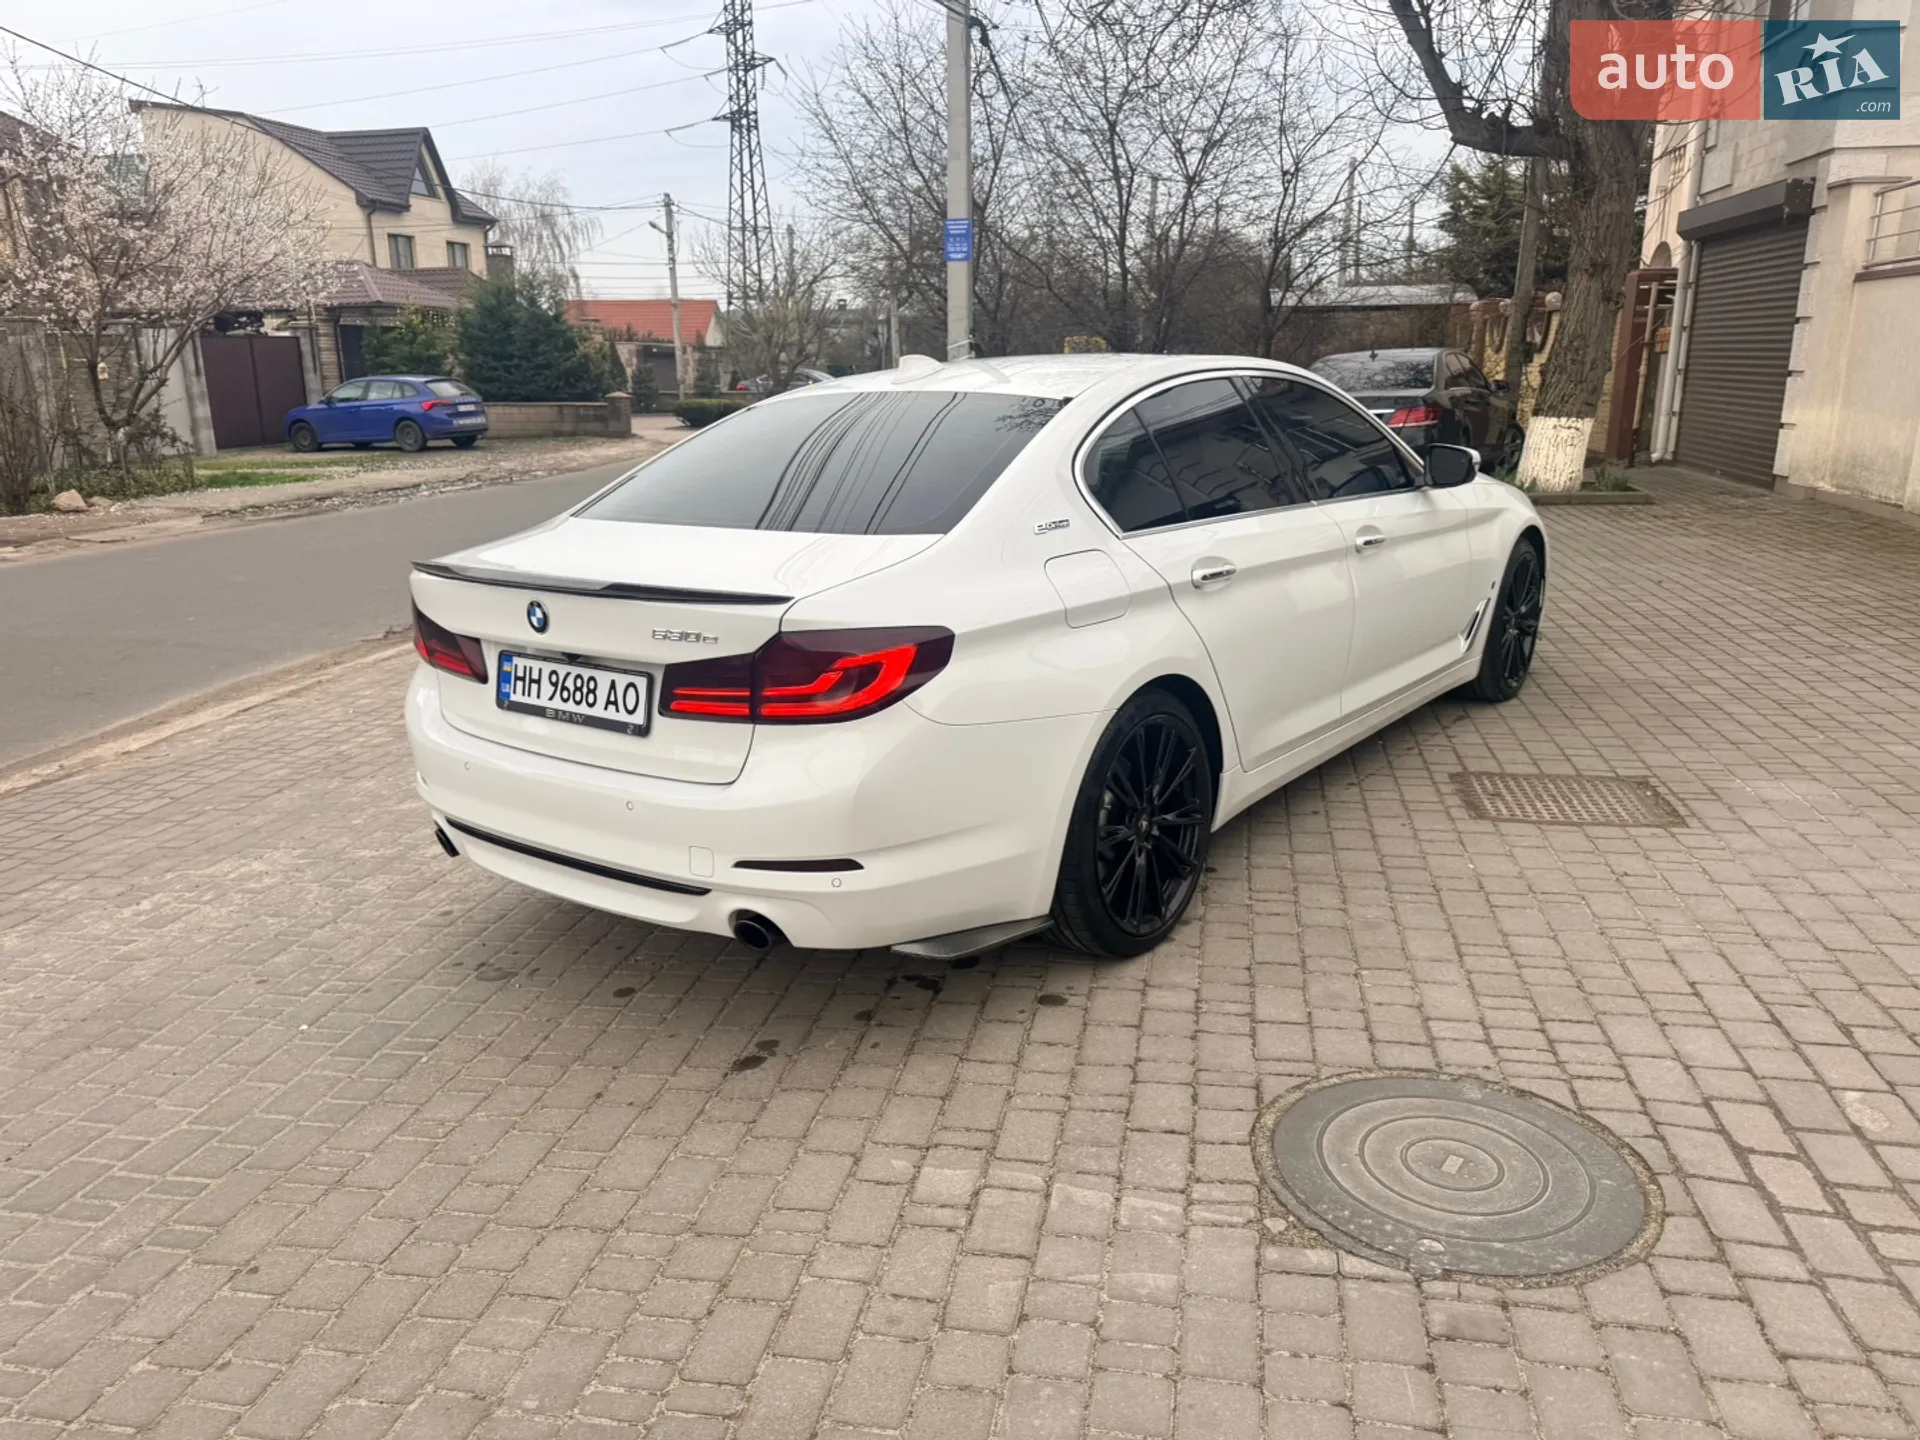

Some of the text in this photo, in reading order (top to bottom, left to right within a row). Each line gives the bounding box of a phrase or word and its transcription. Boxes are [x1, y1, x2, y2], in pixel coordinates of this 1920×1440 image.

[513, 664, 640, 715] HH 9688 AO
[545, 708, 585, 724] BMW
